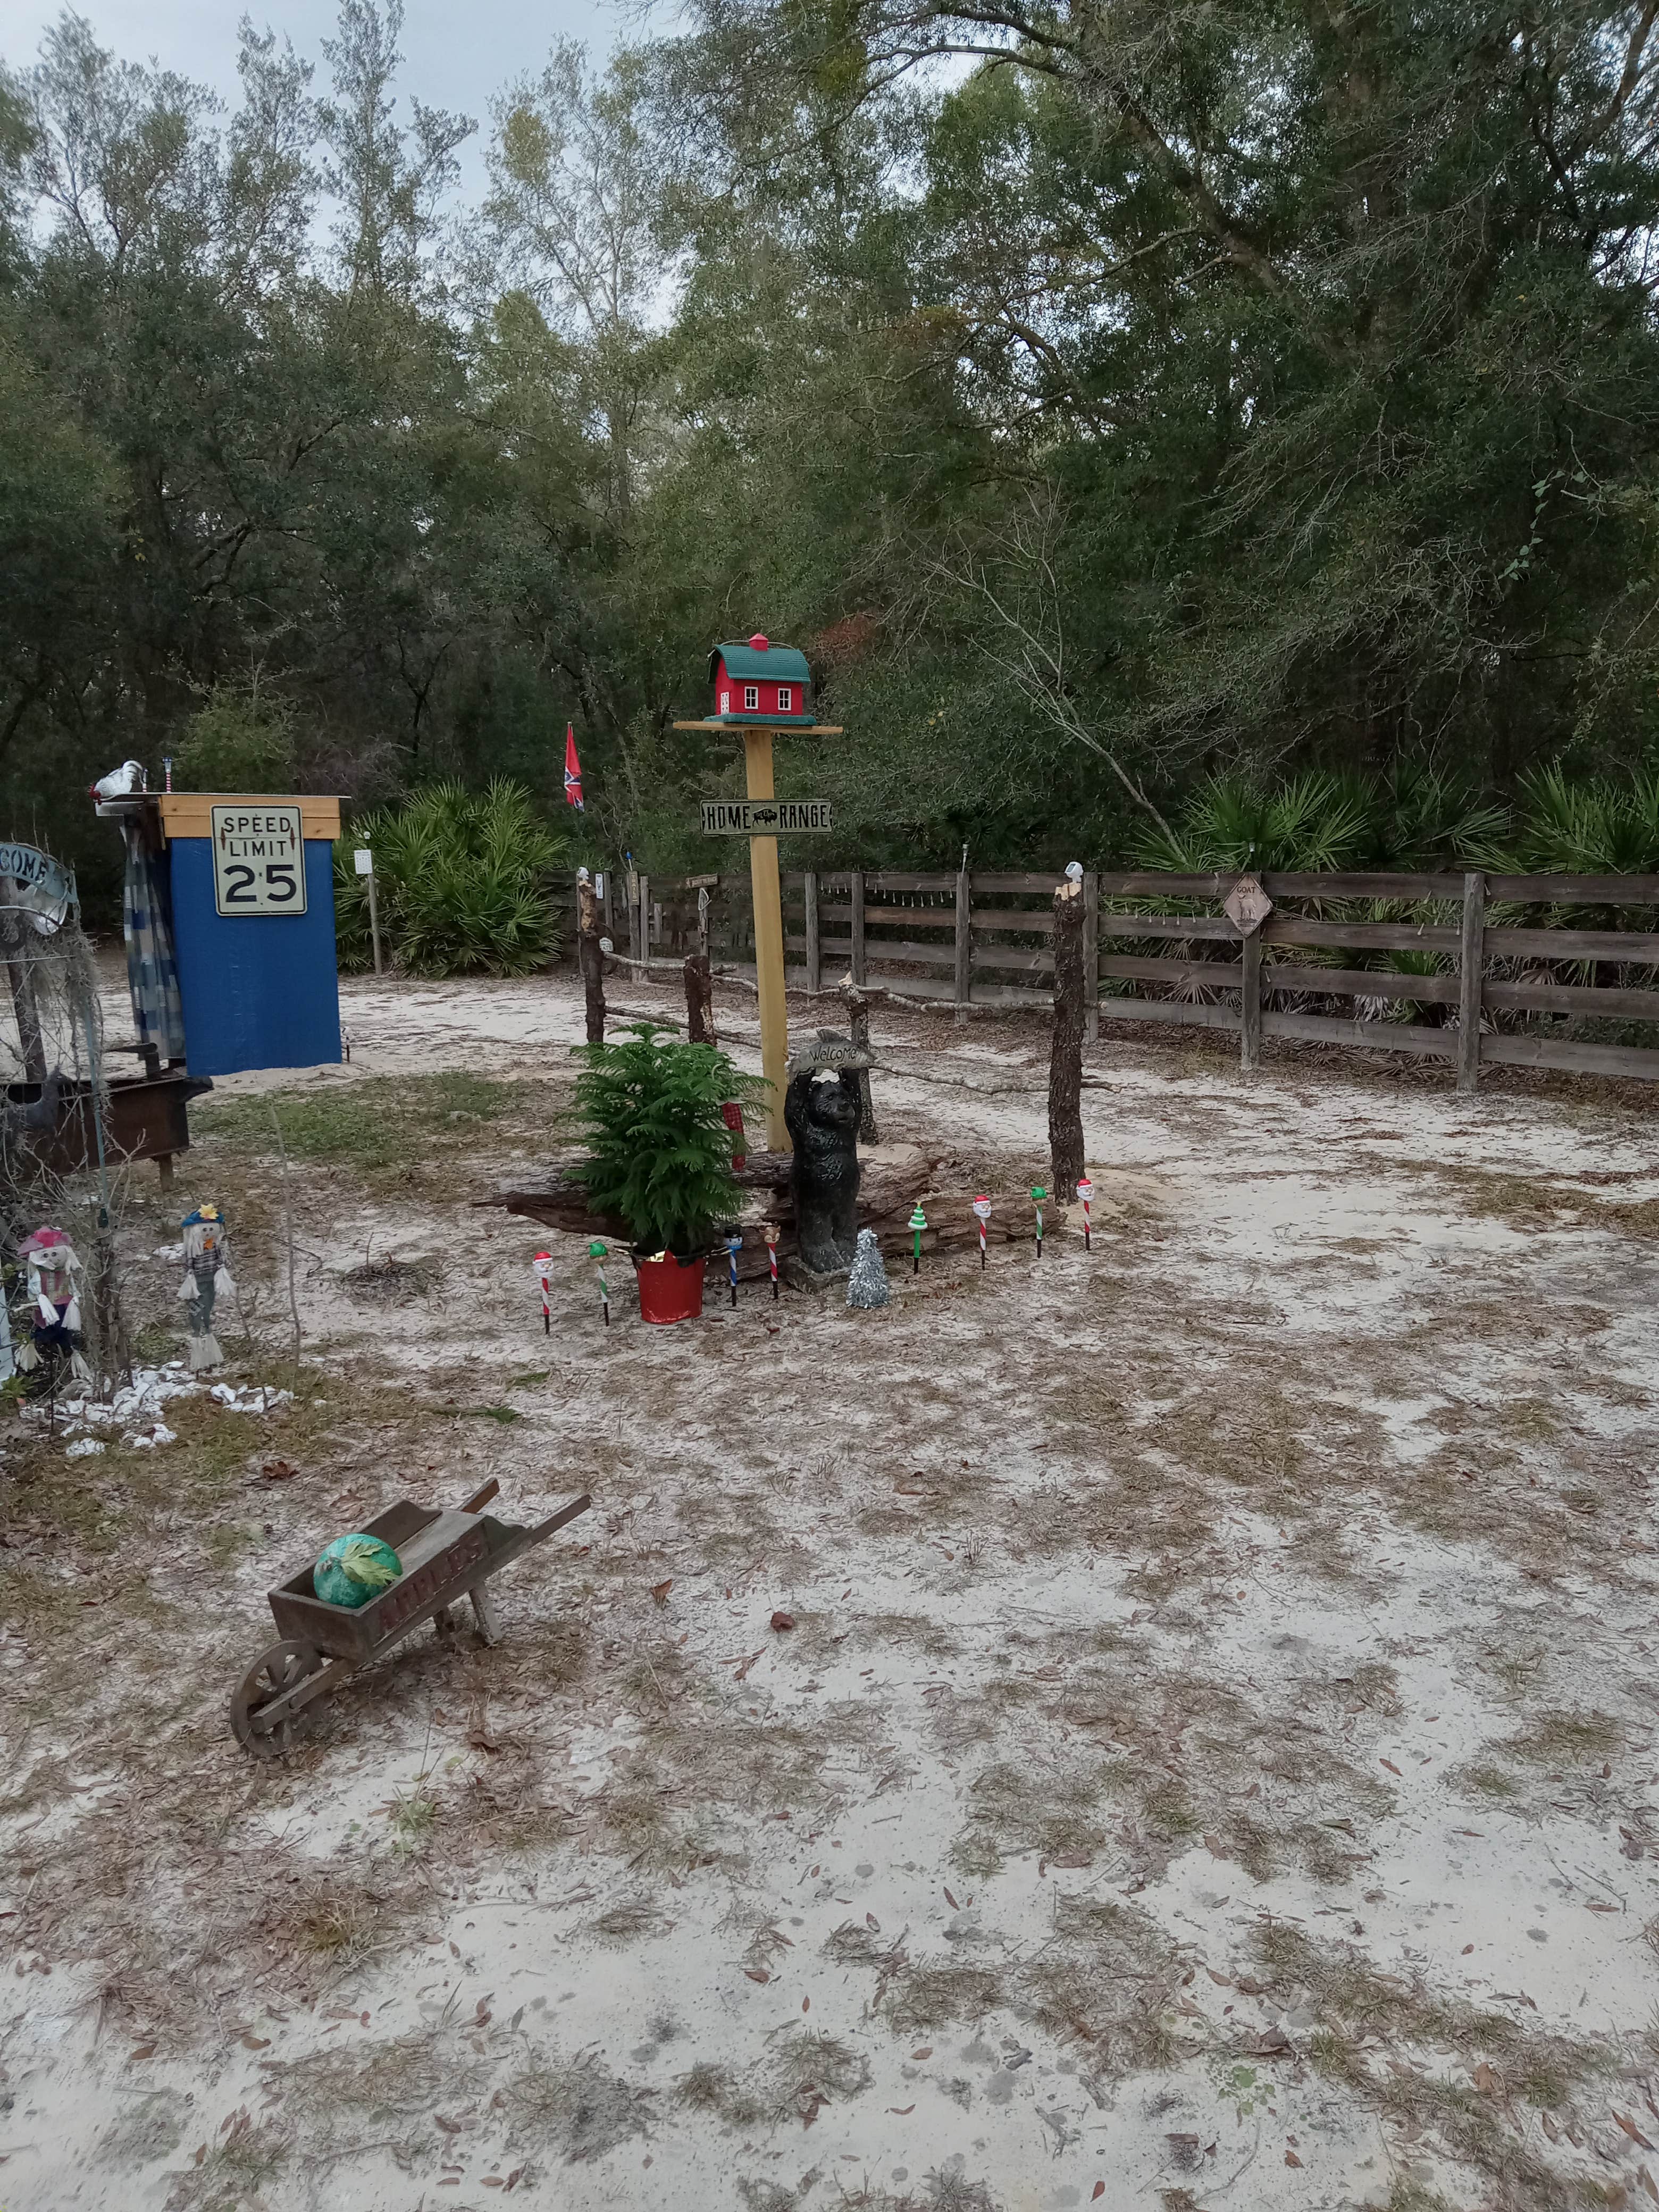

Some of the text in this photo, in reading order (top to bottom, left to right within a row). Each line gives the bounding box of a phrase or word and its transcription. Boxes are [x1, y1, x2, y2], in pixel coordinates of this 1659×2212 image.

[224, 817, 291, 833] SPEED
[707, 806, 751, 830] HOME
[779, 805, 828, 828] RANGE
[230, 841, 287, 857] LIMIT
[223, 865, 297, 903] 25
